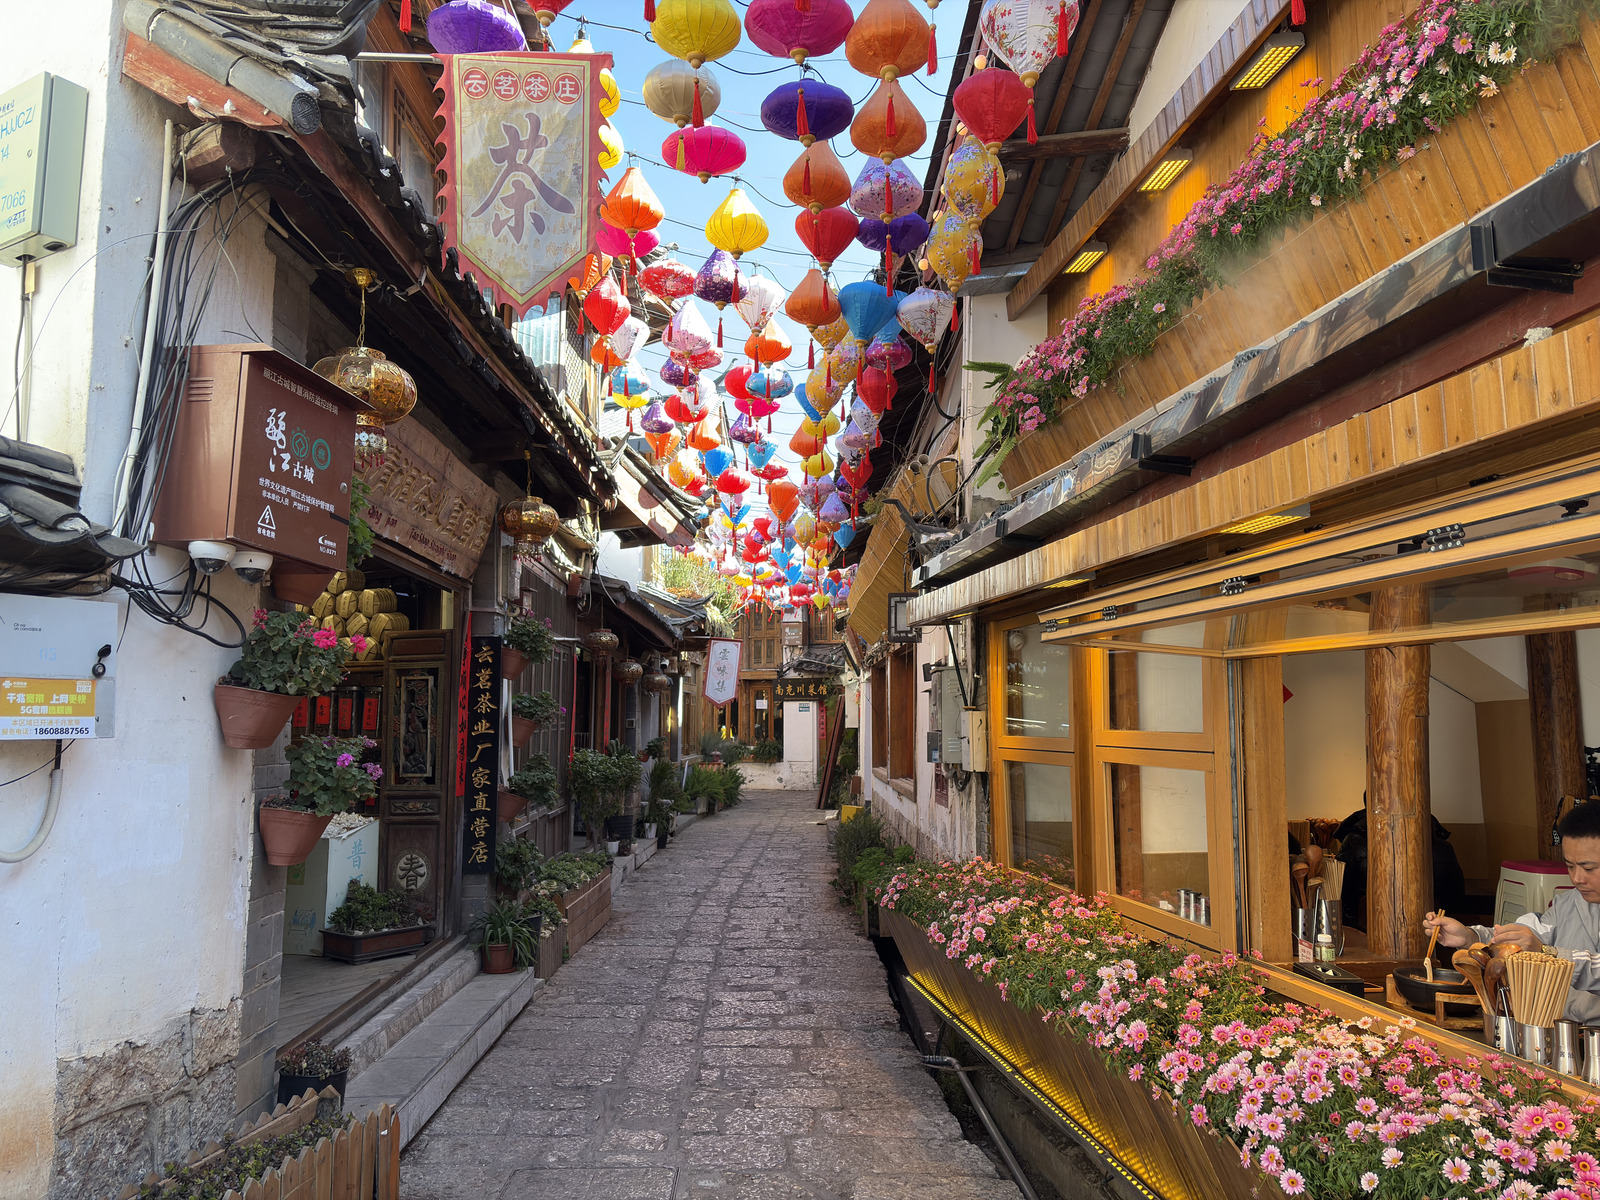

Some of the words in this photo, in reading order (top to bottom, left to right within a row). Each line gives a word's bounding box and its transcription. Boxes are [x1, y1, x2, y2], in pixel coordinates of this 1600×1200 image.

[464, 75, 577, 99] 云茗茶庄
[470, 112, 576, 244] 茶
[293, 461, 314, 485] 古城
[257, 526, 276, 540] 有电危险
[774, 683, 828, 697] 南充川菜馆
[7, 693, 45, 704] 千兆宽带
[50, 693, 87, 704] 上网更快
[20, 706, 73, 715] 5G宽带选联通
[12, 719, 81, 727] 本区域已开通千兆宽带
[34, 727, 90, 736] 18608887565
[467, 645, 498, 865] 云茗茶业厂家直营店
